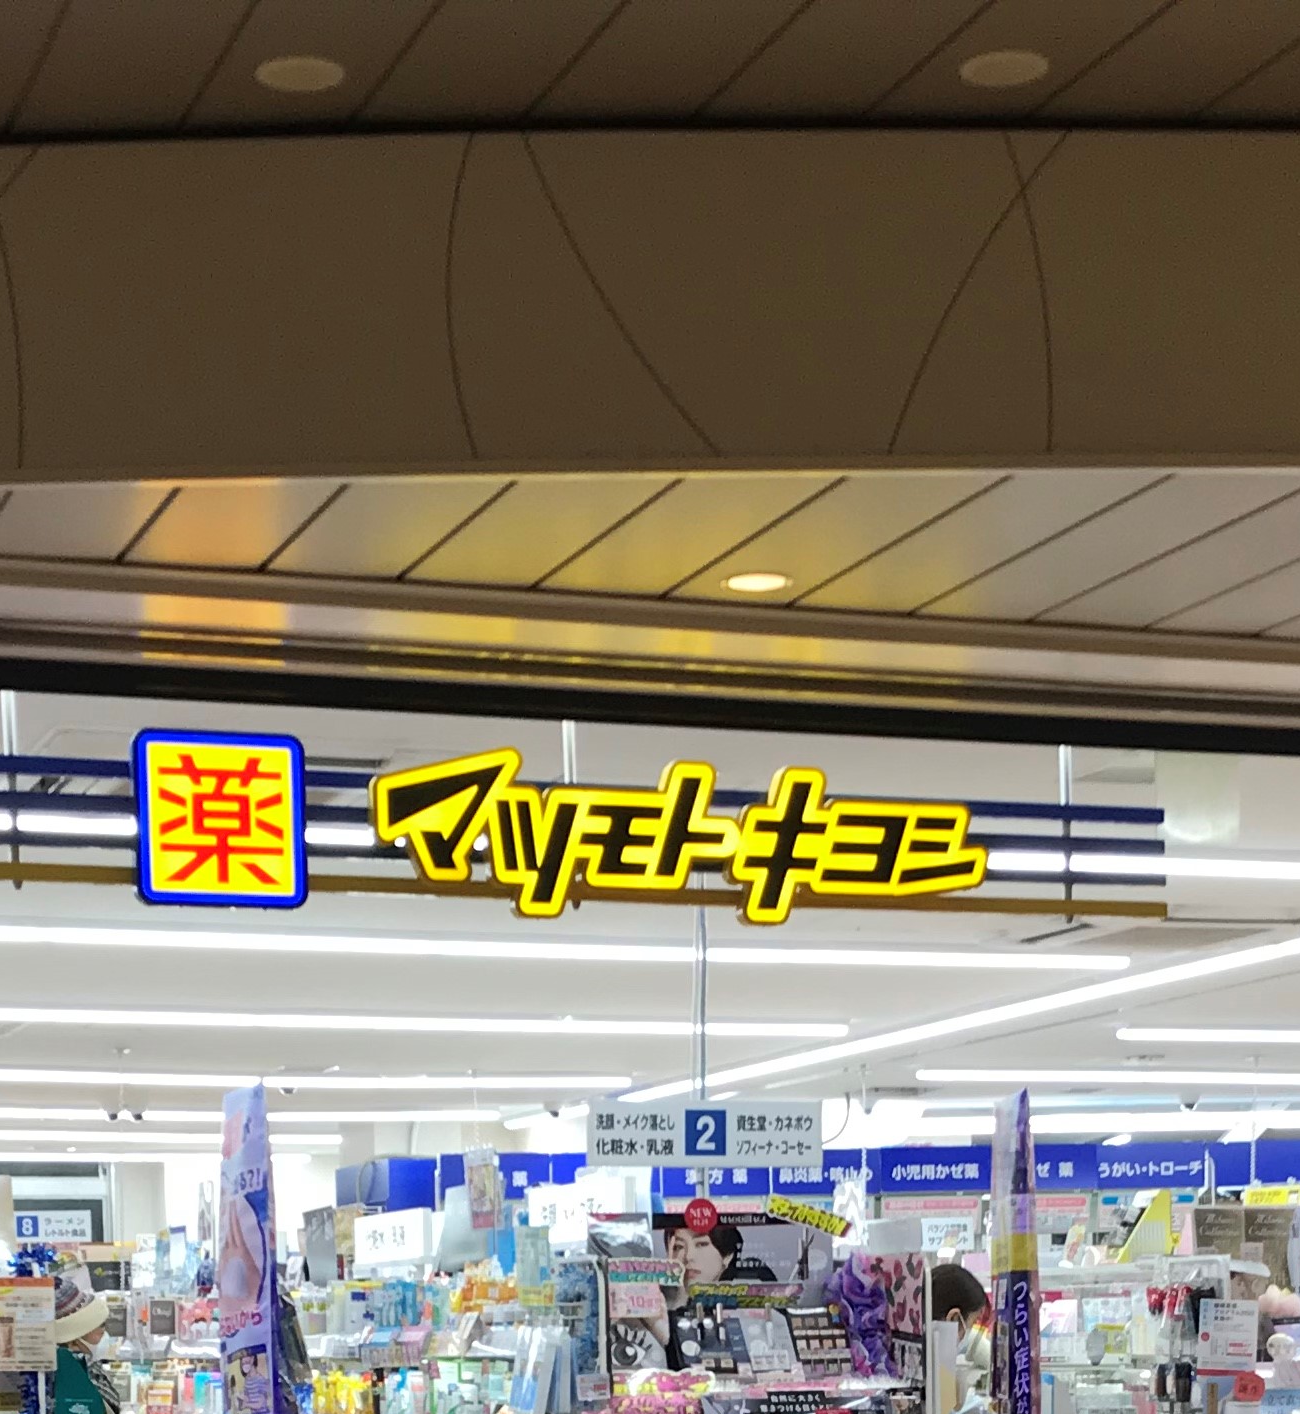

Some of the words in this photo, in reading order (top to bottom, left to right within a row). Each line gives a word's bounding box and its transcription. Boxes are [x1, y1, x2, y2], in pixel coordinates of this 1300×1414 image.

[157, 755, 284, 885] 薬
[378, 752, 988, 919] マツモトキヨシ
[596, 1113, 675, 1131] 洗顔・メイク落とし
[736, 1114, 813, 1132] 資生堂・カネボウ
[696, 1115, 716, 1151] 2
[596, 1139, 674, 1156] 化粧水・乳液
[736, 1140, 812, 1155] ソフィーナ・コーセー
[892, 1163, 979, 1180] 小児用かぜ薬
[1098, 1162, 1202, 1178] うがい・トローチ
[21, 1218, 33, 1235] 8
[45, 1218, 85, 1226] ラーメン
